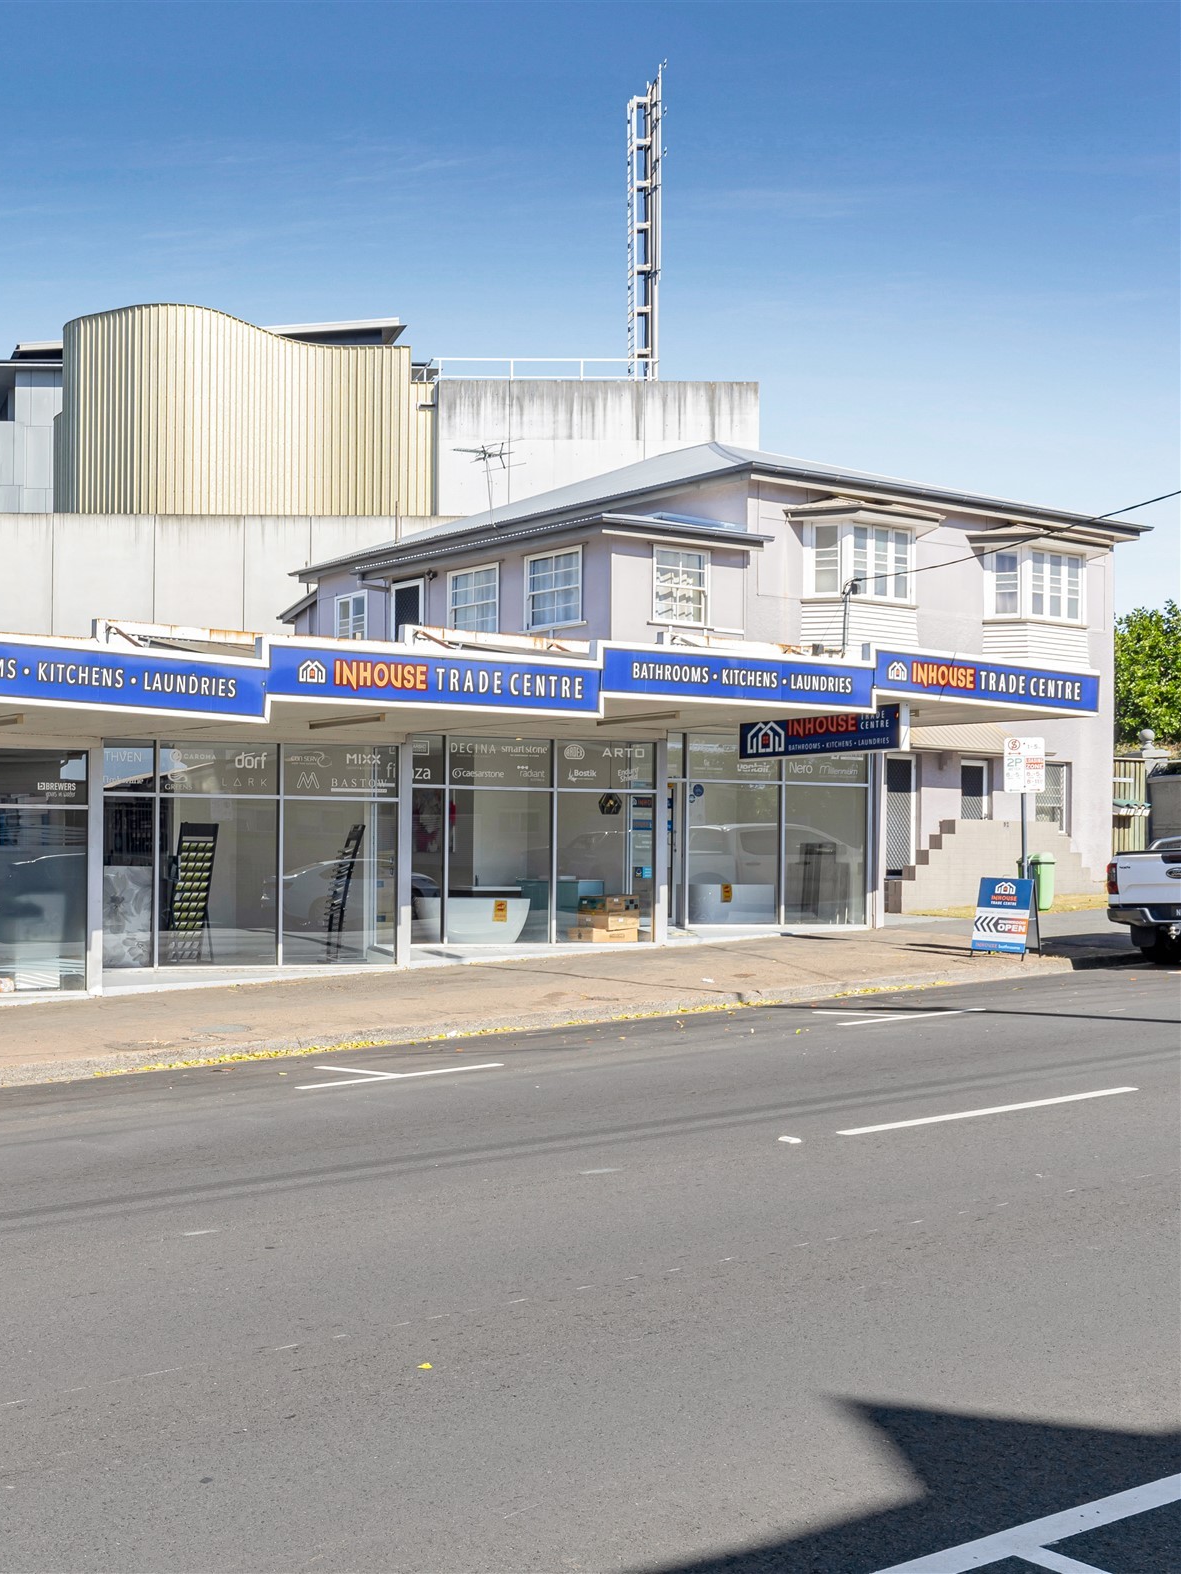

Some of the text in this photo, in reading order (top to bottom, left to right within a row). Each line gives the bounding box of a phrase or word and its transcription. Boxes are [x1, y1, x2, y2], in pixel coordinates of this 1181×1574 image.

[37, 662, 124, 689] KITCHENS
[143, 671, 237, 699] LAUNDRIES
[333, 658, 584, 700] INHOUSE TRADE CENTRE
[631, 662, 853, 694] BATHROOMS KITCHENS LAUNDRIES
[911, 660, 1082, 702] INHOUSE TRADE CENTRE
[787, 713, 858, 738] INHOUSE
[860, 719, 890, 730] CENTRE
[450, 742, 496, 754] DECINA
[788, 736, 890, 752] BATHROOMS KITCHENS LAUNDRIES
[183, 753, 217, 761] CAROMA
[602, 748, 645, 758] ARTO
[346, 753, 381, 765] MIXX
[1007, 758, 1022, 767] 2P
[520, 769, 545, 778] radiant
[574, 769, 597, 777] Bostik
[789, 762, 813, 774] Nero
[462, 770, 505, 778] caesarstone
[46, 782, 77, 791] BREWERS
[331, 778, 388, 788] BASTOW
[997, 923, 1026, 933] OPEN
